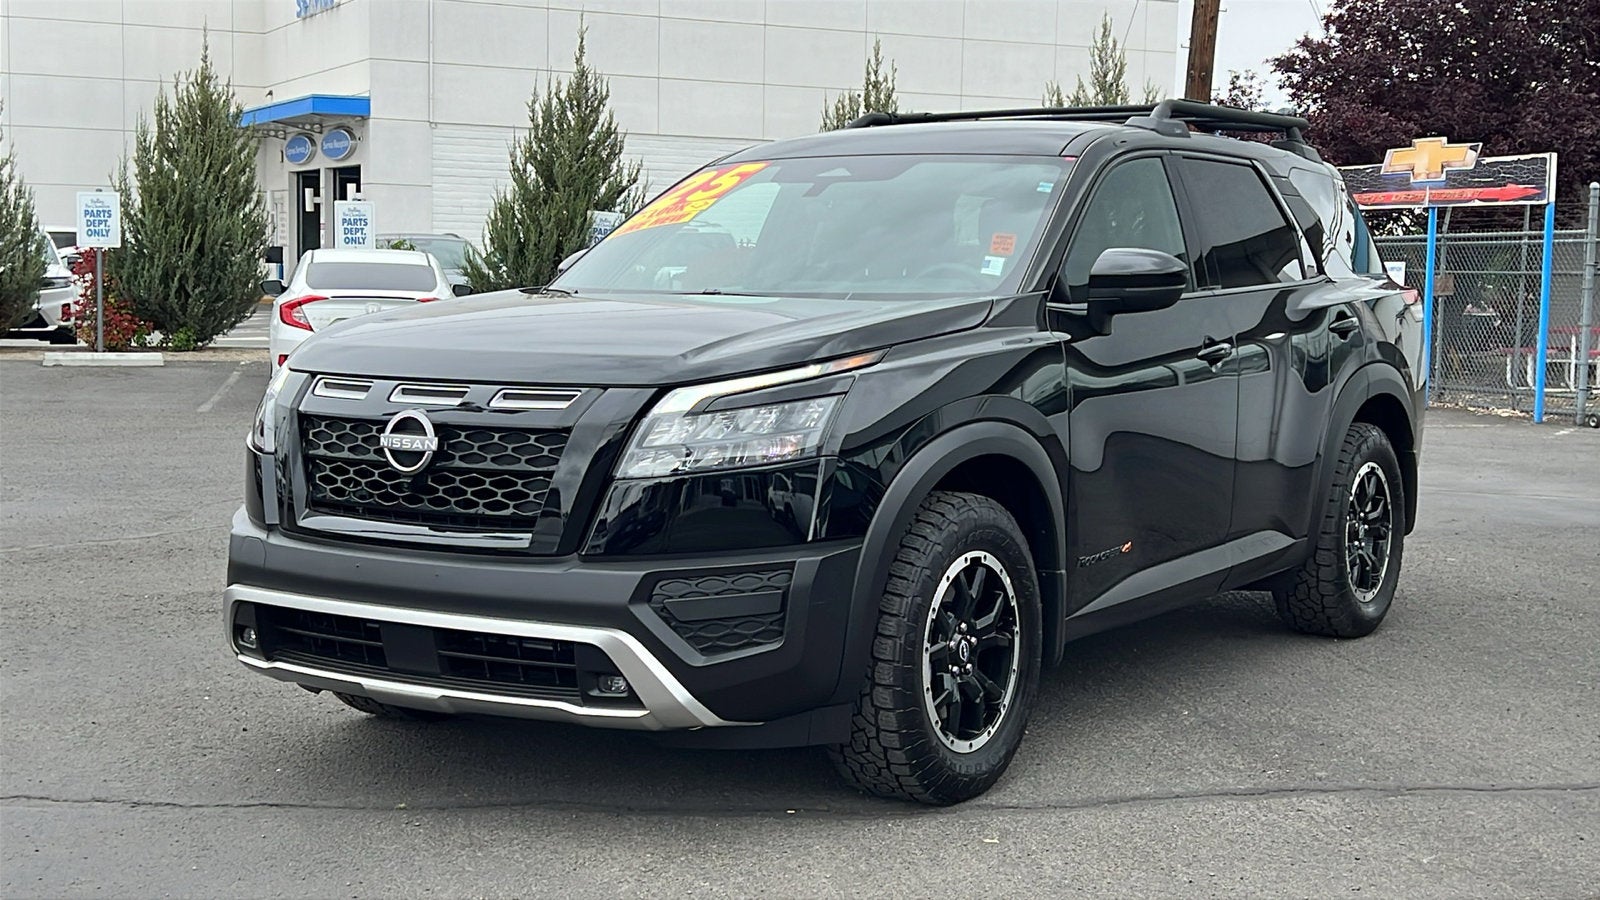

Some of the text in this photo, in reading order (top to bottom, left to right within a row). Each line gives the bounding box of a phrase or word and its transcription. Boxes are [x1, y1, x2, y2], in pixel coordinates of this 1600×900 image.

[84, 209, 112, 218] PARTS
[86, 219, 110, 228] DEPT.
[342, 217, 369, 227] PARTS
[86, 228, 110, 238] ONLY
[343, 227, 367, 236] DEPT.
[343, 236, 367, 245] ONLY
[380, 435, 436, 451] NISSAN
